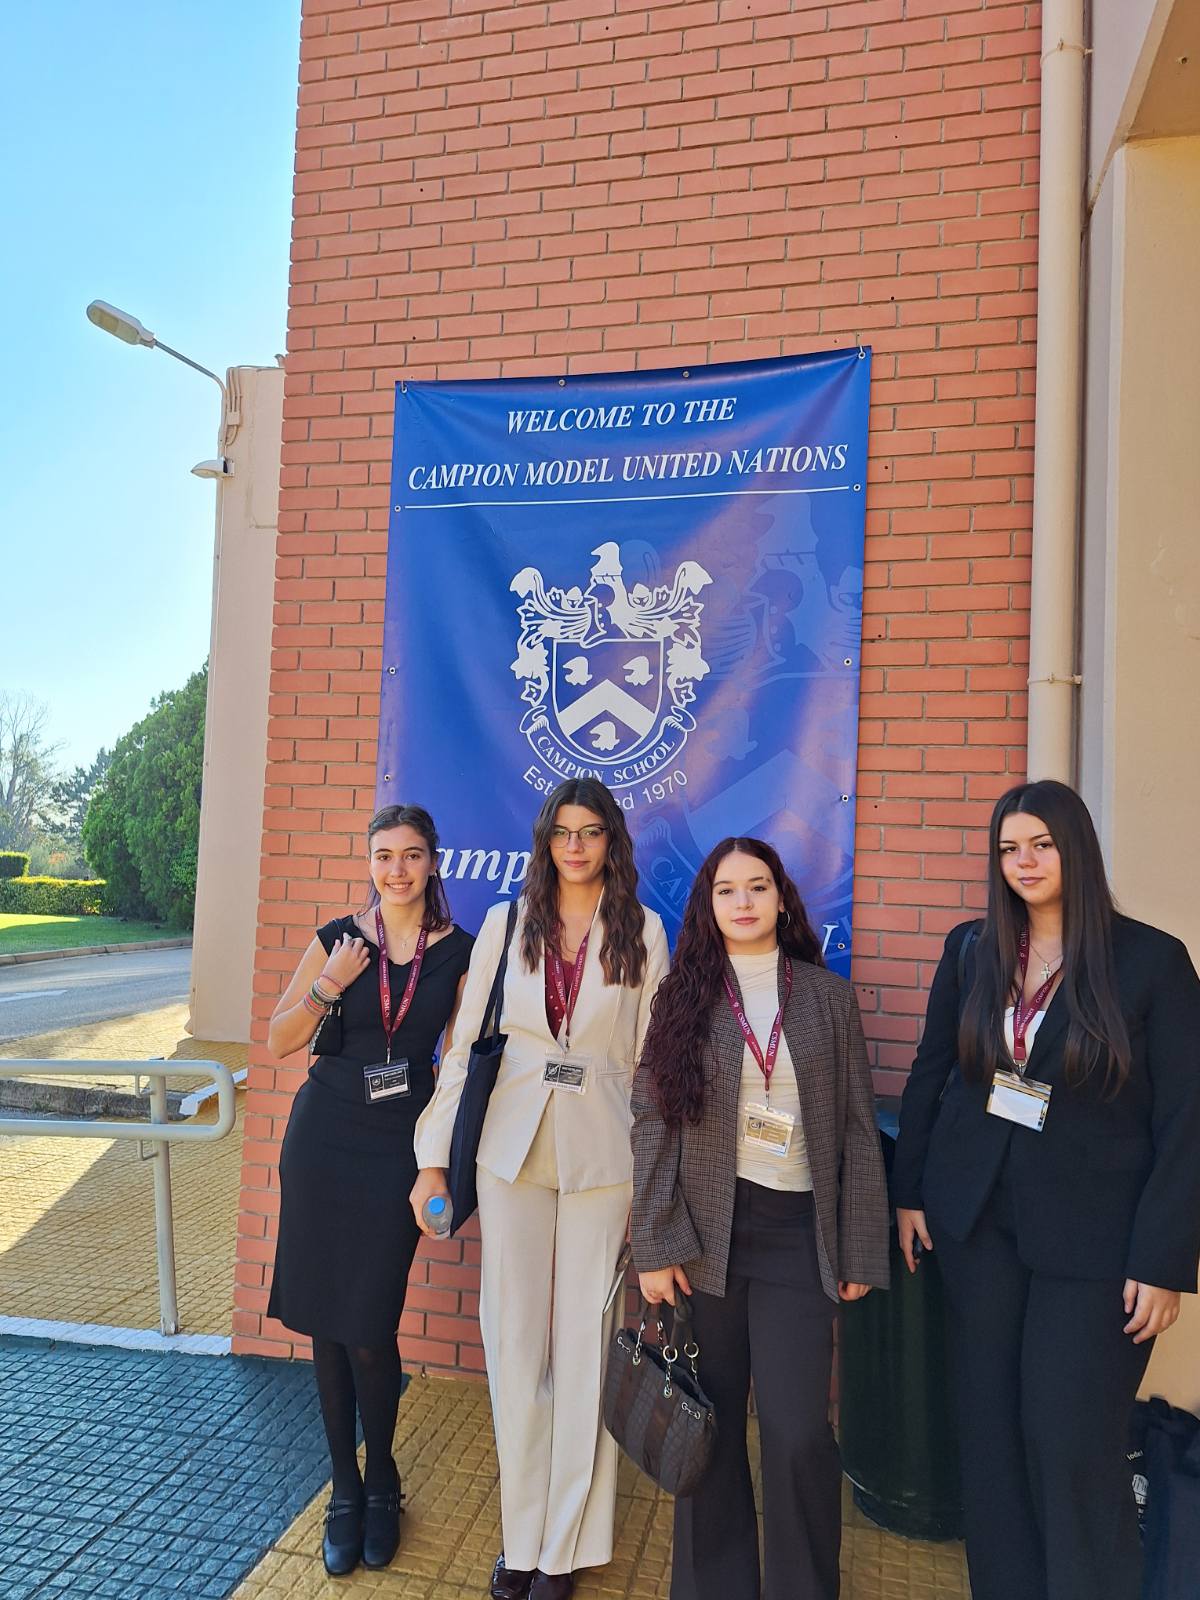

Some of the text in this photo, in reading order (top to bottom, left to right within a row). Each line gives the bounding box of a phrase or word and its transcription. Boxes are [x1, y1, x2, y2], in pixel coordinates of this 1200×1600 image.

[507, 397, 737, 435] WELCOME TO THE
[408, 443, 848, 491] CAMPION MODEL UNITED NATIONS
[537, 735, 675, 783] CAMPION SCHOOL
[642, 769, 688, 804] 1970
[737, 1012, 752, 1035] CSMUN
[768, 1031, 778, 1057] CSMUN
